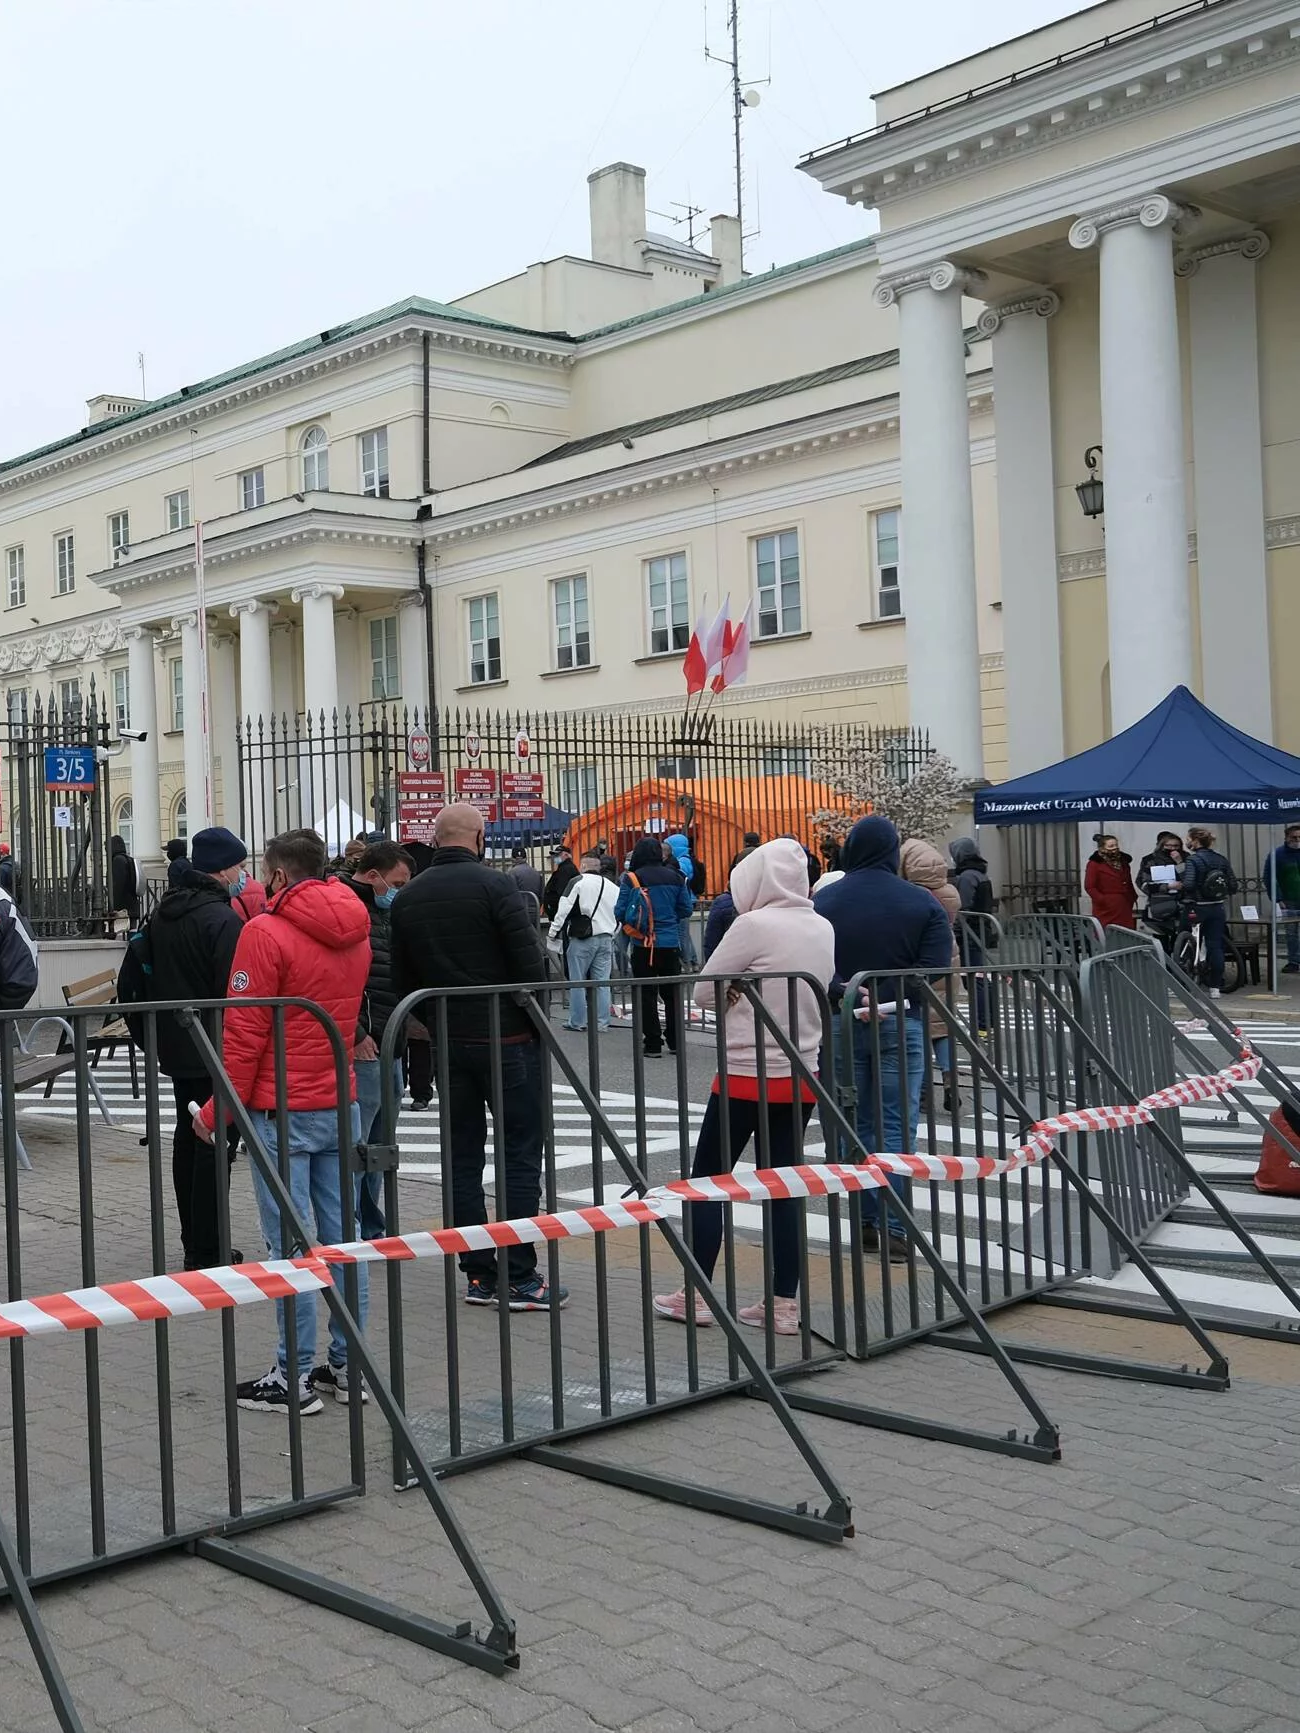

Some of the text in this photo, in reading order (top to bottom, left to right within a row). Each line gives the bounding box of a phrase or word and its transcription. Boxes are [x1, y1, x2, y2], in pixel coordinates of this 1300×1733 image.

[56, 757, 85, 783] 3/5
[983, 800, 1051, 812] Mazowiecki
[1054, 799, 1092, 811] Urząd
[1095, 797, 1174, 809] Wojewódzki
[1193, 799, 1269, 809] Warszawie
